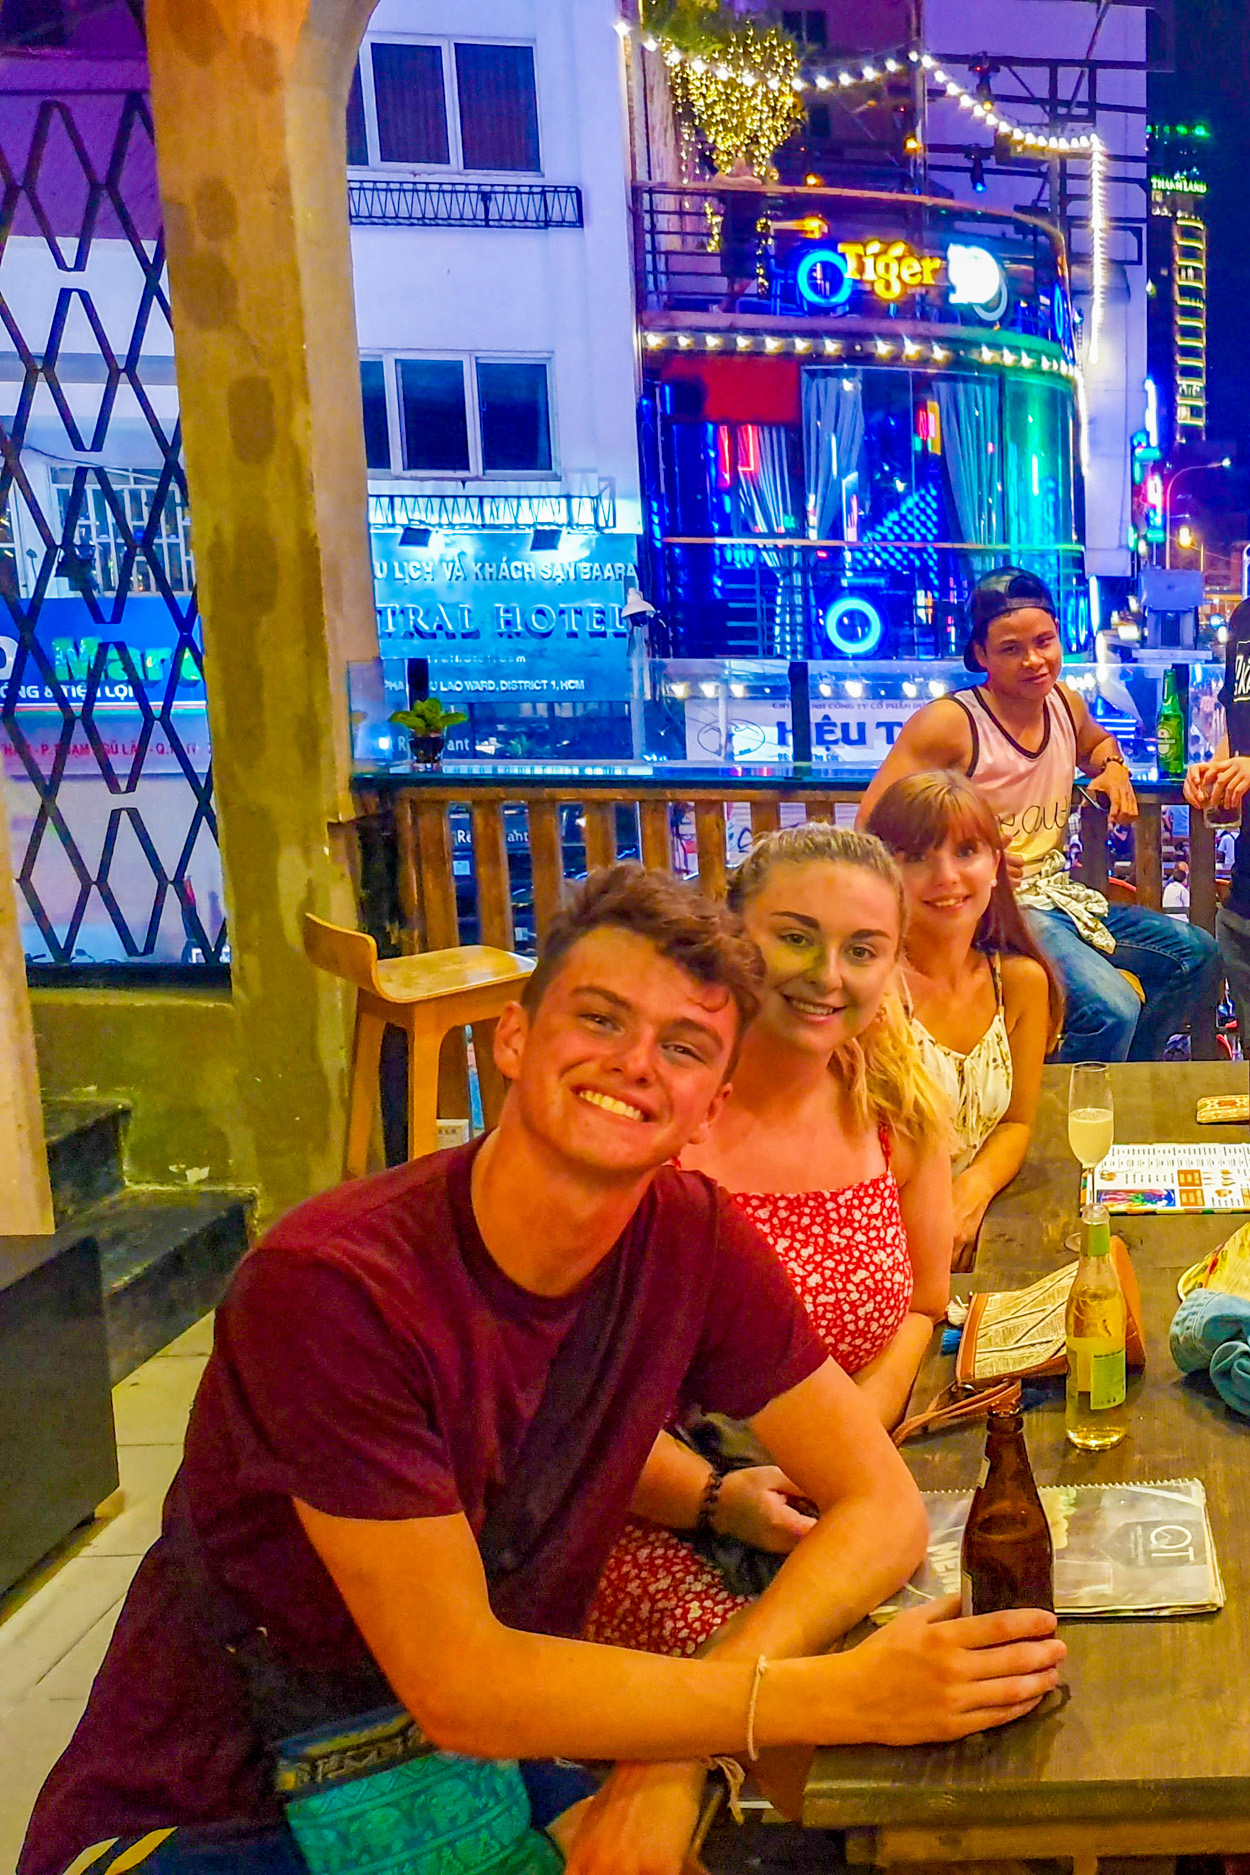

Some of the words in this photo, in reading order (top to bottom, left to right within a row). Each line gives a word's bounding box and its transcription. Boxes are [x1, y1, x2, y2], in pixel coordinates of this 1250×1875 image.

[837, 240, 941, 299] Tiger
[394, 561, 434, 585] LỊCH
[473, 556, 536, 580] KHÁCH
[494, 603, 627, 635] HOTEL
[500, 680, 548, 691] DISTRICT
